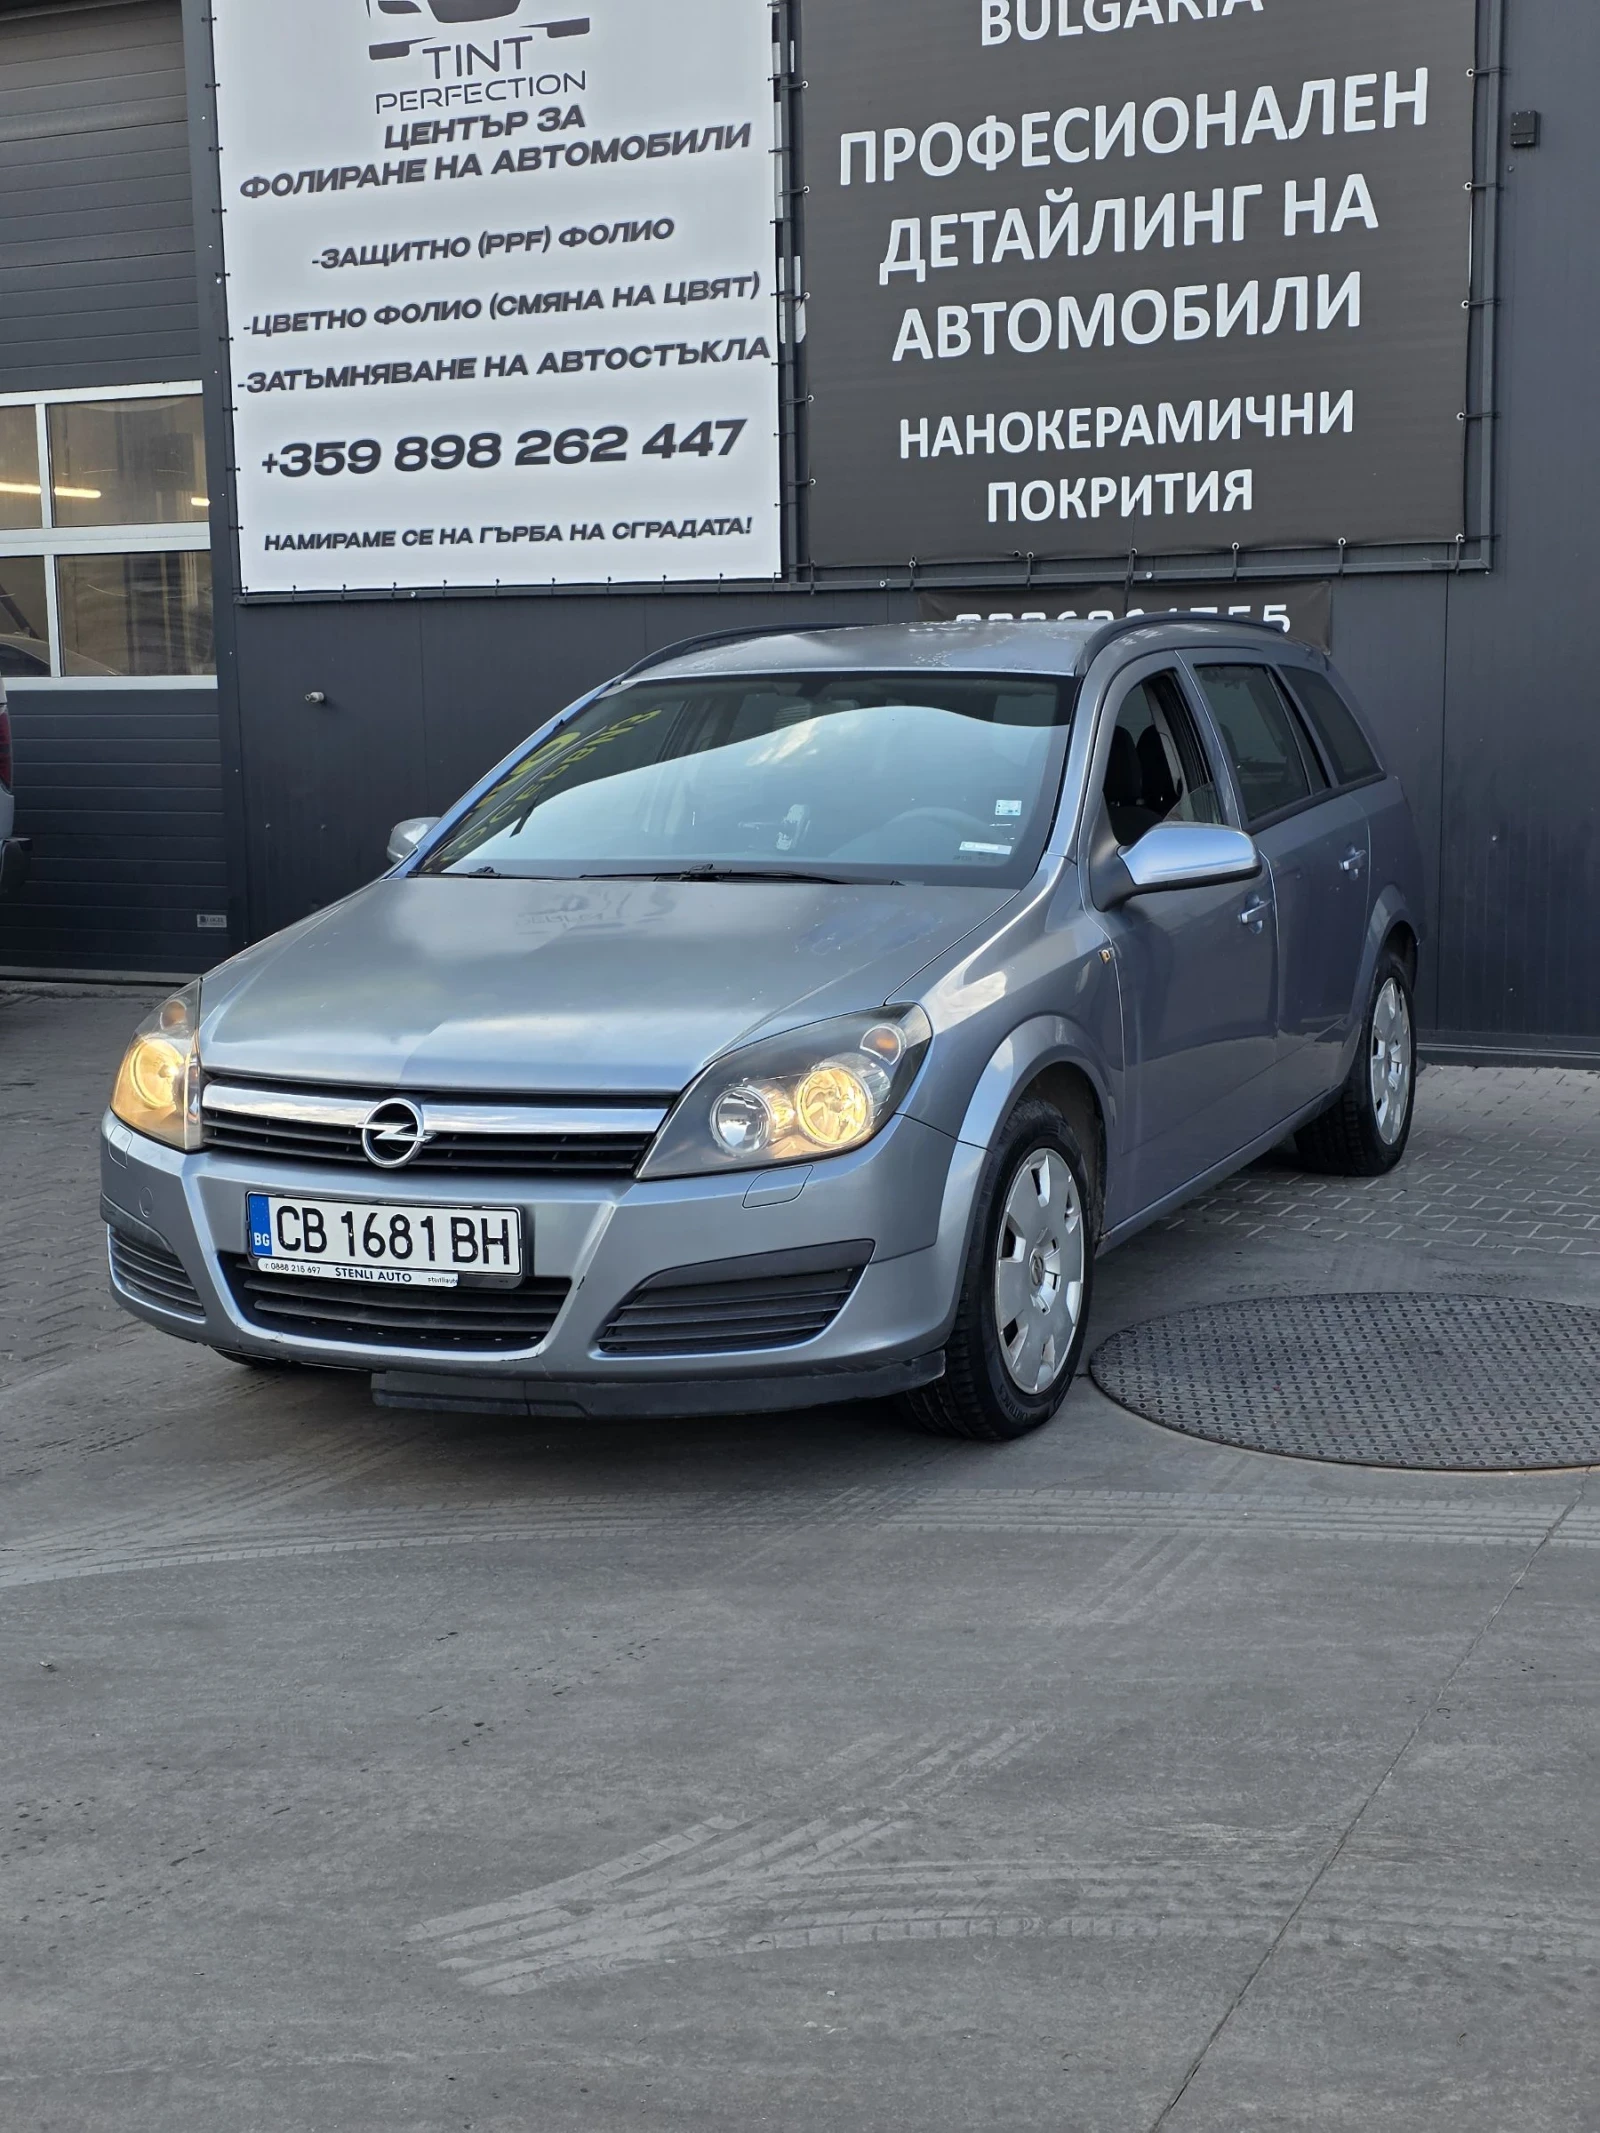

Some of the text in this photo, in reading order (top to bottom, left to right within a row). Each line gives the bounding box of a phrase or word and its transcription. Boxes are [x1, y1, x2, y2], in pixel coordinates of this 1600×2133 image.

[982, 0, 1264, 47] BULGA
[423, 36, 533, 80] TINT
[376, 70, 586, 115] PERFECTION
[385, 105, 586, 151] ЦЕНТЪР ЗА
[841, 67, 1428, 186] ПРОФЕСИОНАЛЕН
[240, 123, 751, 199] ФОЛИРАНЕ НА АВТОМОБИЛИ
[312, 219, 675, 270] -ЗАЩИТНО (PPF) ФОЛИО
[879, 174, 1379, 286] ДЕТАЙЛИНГ НА
[243, 271, 760, 338] -ЦВЕТНО ФОЛИО (СМЯНА НА ЦВЯТ)
[892, 271, 1361, 362] АВТОМОБИЛИ
[237, 337, 771, 394] -ЗАТЪМНЯВАНЕ НА АВТОСТЪКЛА
[262, 418, 748, 478] +359 898 262 447
[900, 390, 1354, 458] НАНОКЕРАМИЧНИ
[988, 469, 1253, 523] ПОКРИТИЯ
[265, 517, 753, 551] НАМИРАМЕ СЕ НА ГЪРБА НА СГРАДАТА!
[254, 1205, 511, 1265] BG CB 1681 BH
[335, 1267, 412, 1283] STENLI AUTO
